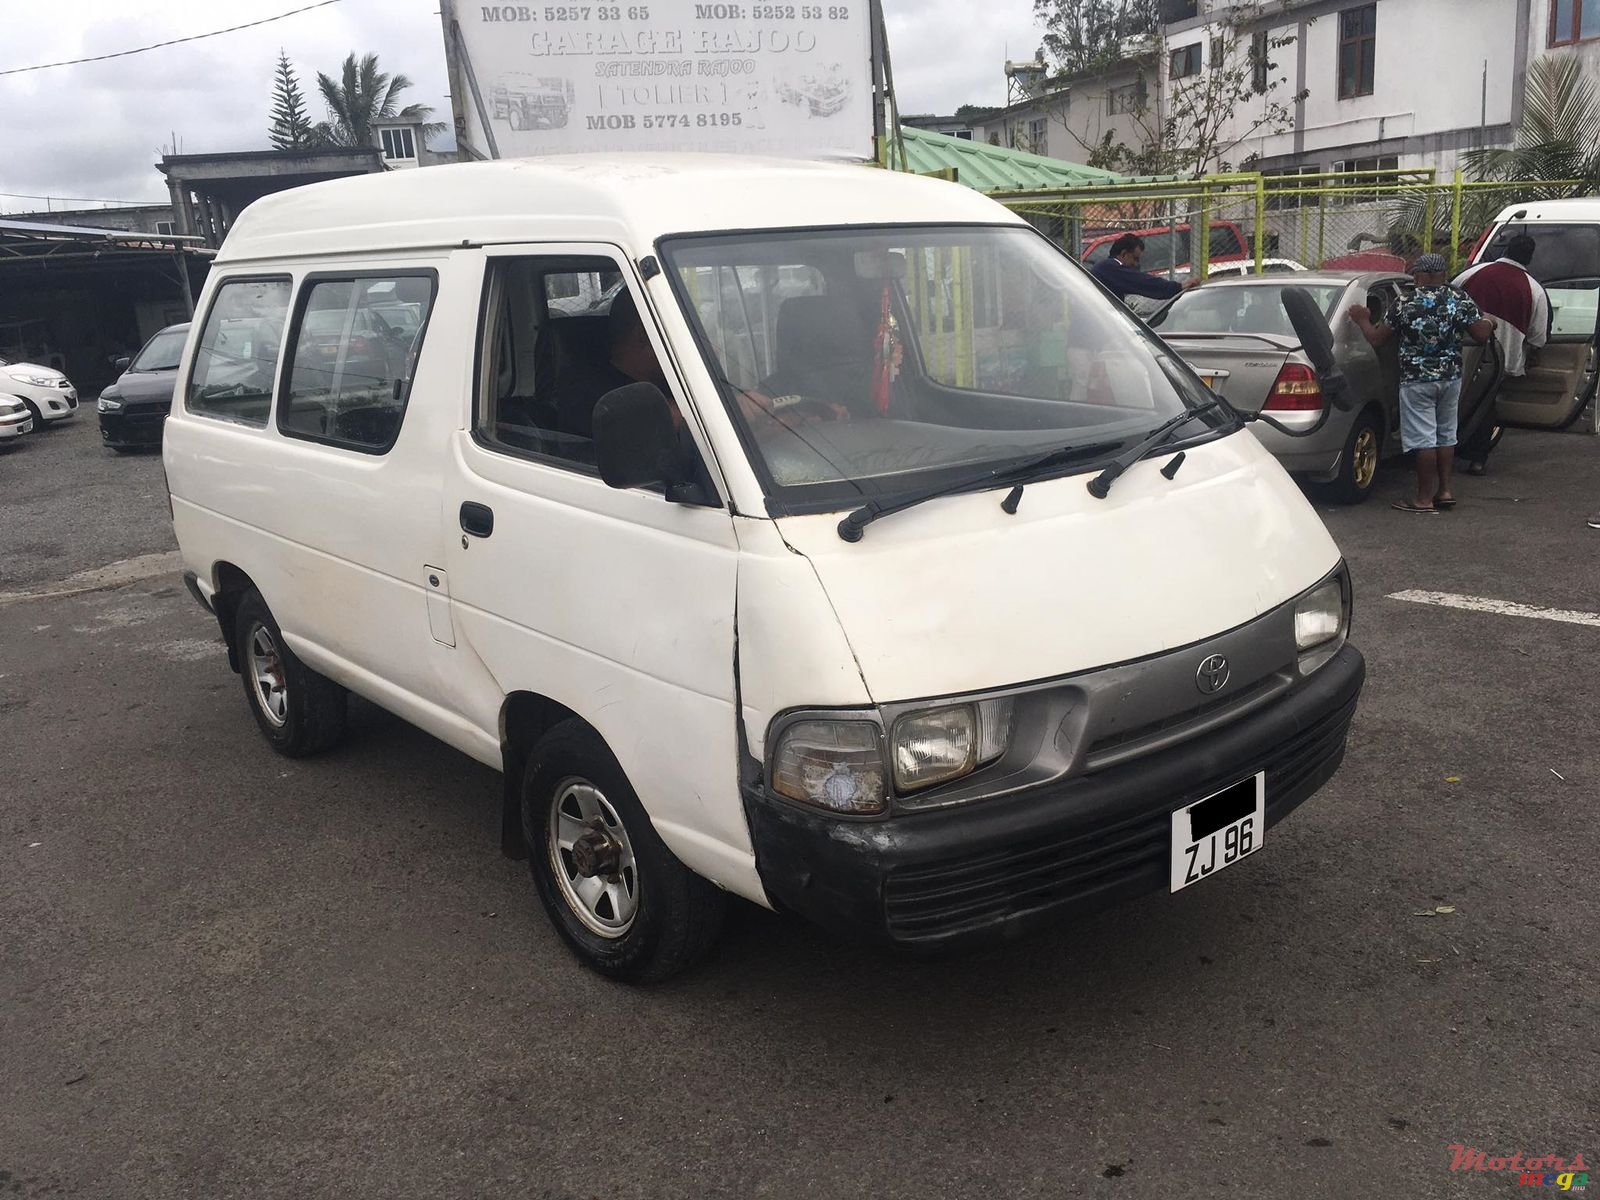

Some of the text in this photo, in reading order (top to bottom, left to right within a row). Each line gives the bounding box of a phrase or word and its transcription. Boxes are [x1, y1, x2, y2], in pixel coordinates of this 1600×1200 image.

[481, 6, 650, 22] MOB: 5257 33 65
[695, 4, 849, 20] MOB: 5252 53 82
[529, 29, 816, 56] GARAGE RAJOO
[595, 58, 757, 77] SATENDRA RAJOO
[586, 112, 743, 130] MOB 5774 8195
[1185, 818, 1253, 884] ZJ 96
